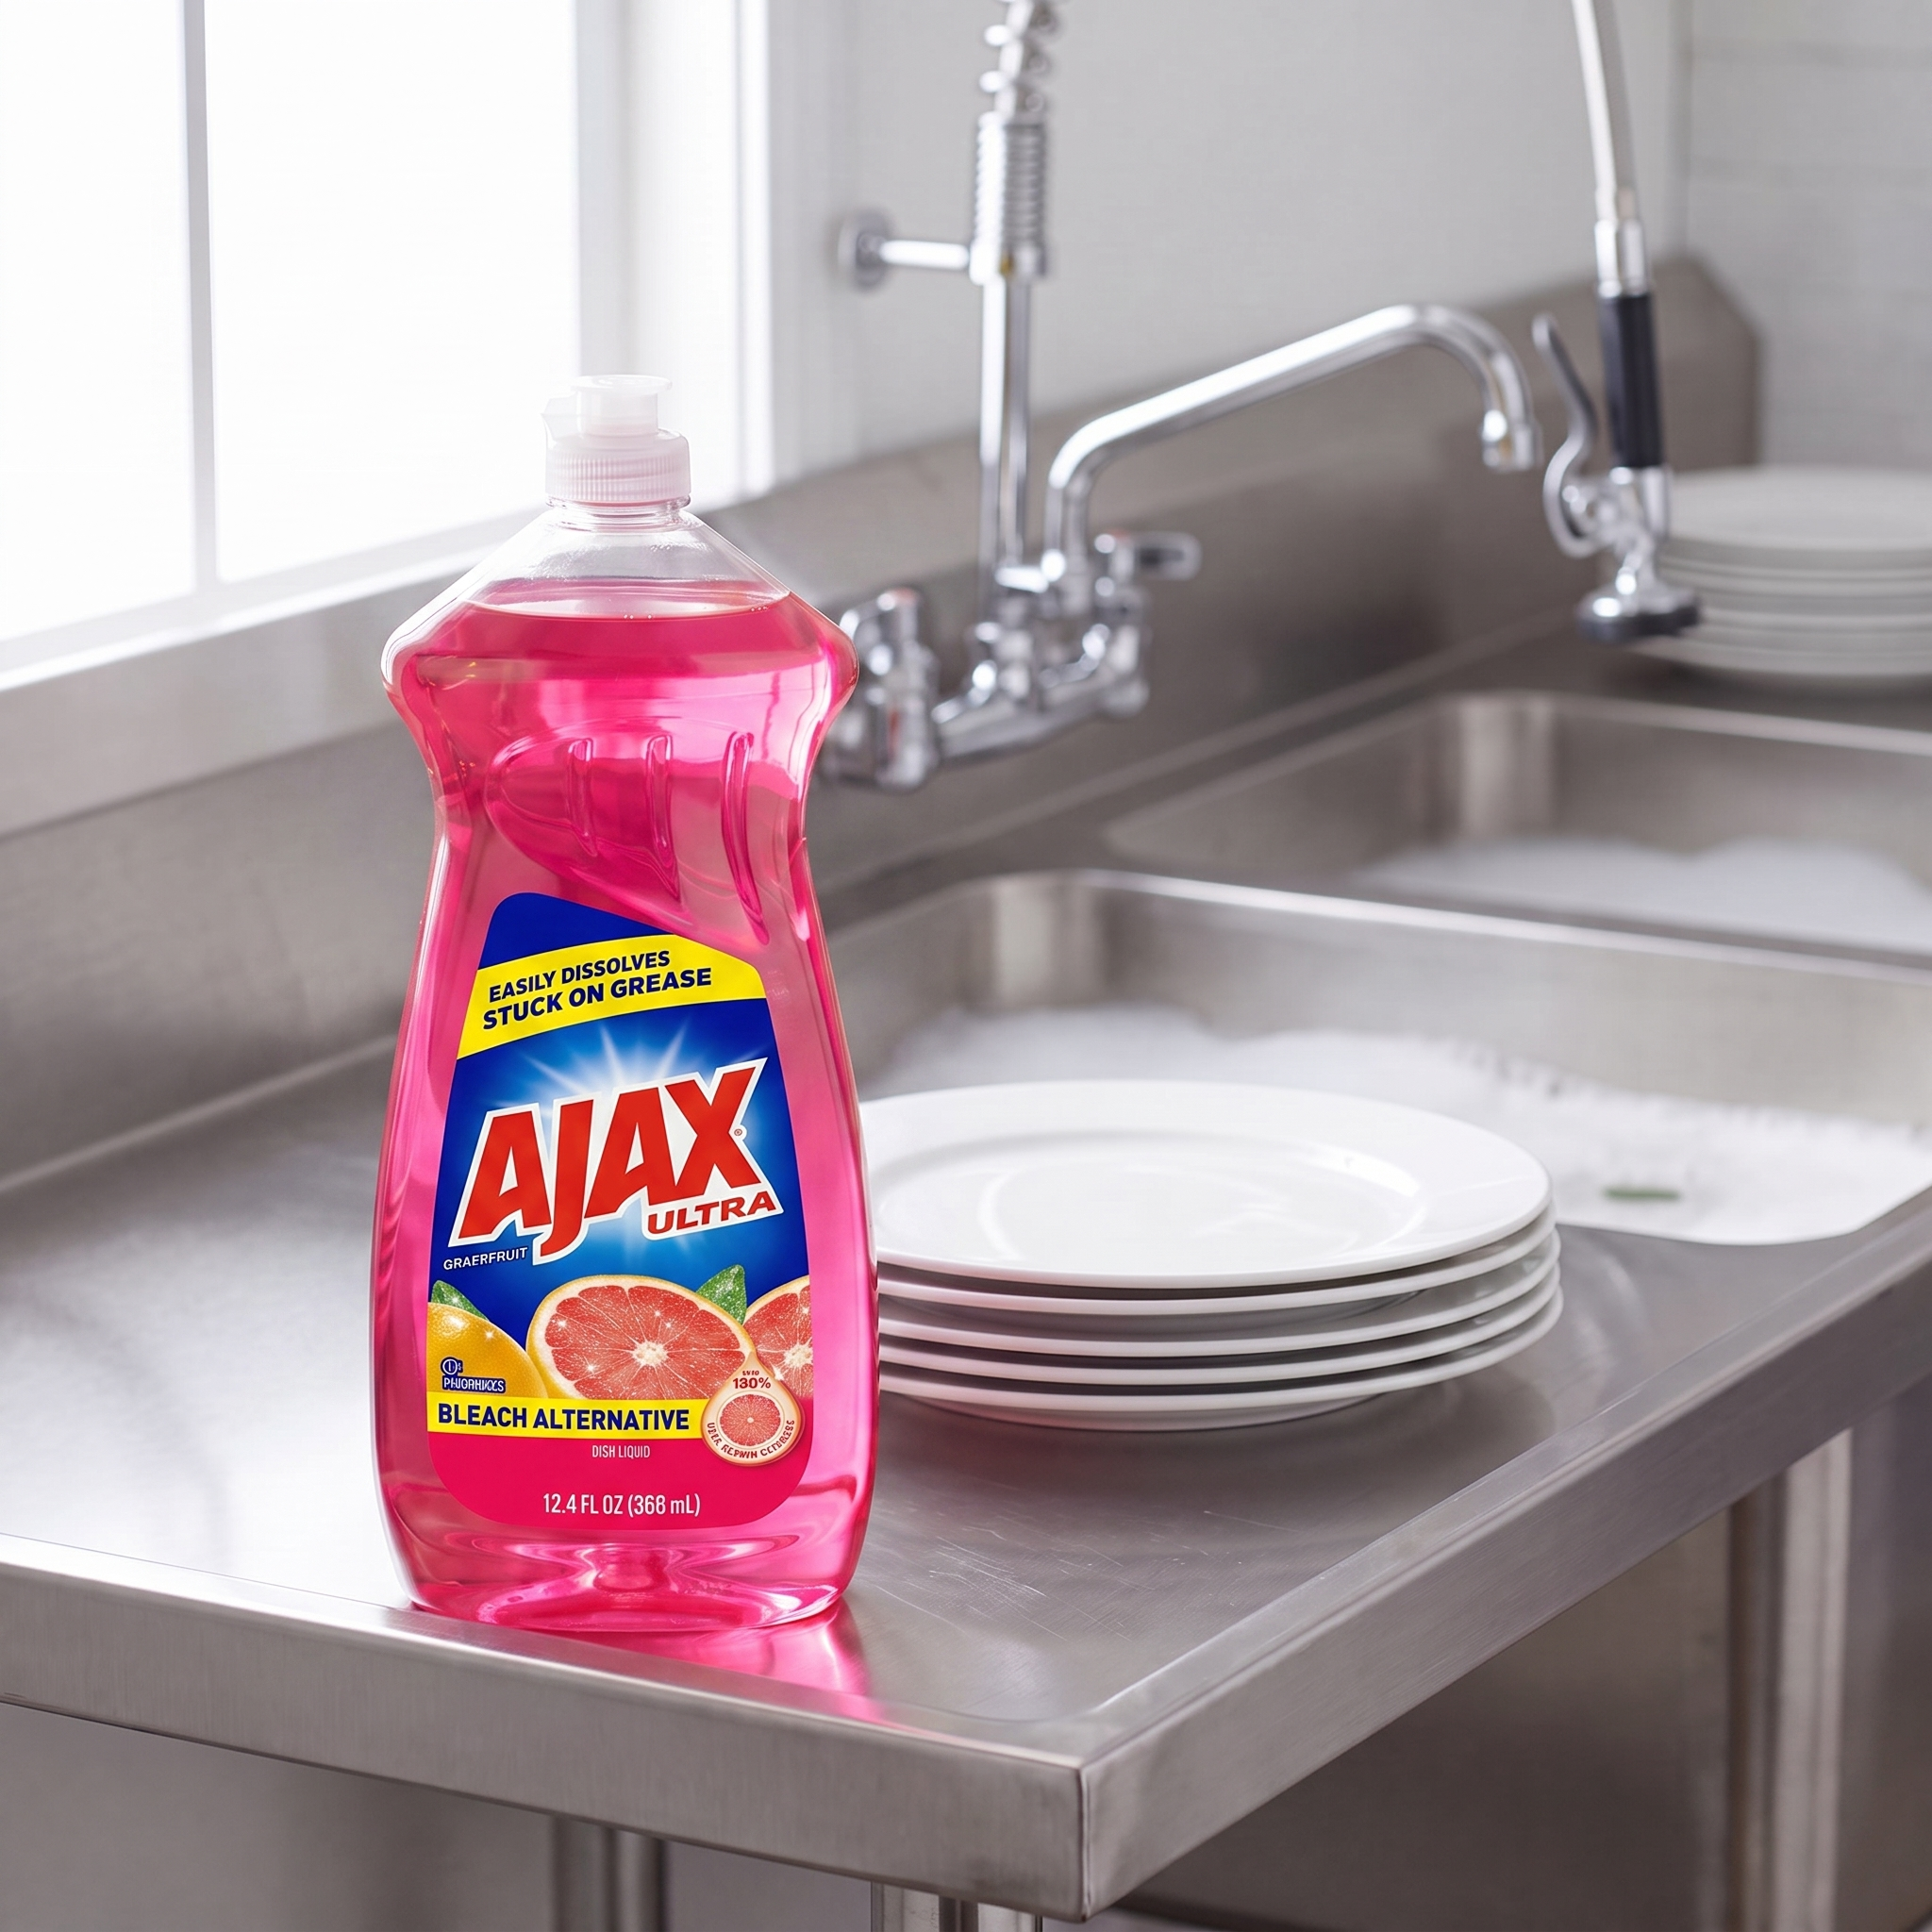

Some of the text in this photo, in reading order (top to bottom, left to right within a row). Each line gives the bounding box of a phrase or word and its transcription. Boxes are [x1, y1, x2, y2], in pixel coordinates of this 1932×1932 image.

[489, 950, 670, 1003] EASILY DISSOLVES
[482, 968, 711, 1029] STUCK ON GREASE
[456, 1064, 763, 1259] AJAX
[648, 1191, 776, 1235] ULTRA
[443, 1247, 527, 1270] GRAERFRUIT
[439, 1403, 690, 1431] BLEACH ALTERNATIVE
[591, 1445, 651, 1459] DISH LIQUID
[542, 1493, 701, 1518] 12.4 FL OZ (368 mL)
